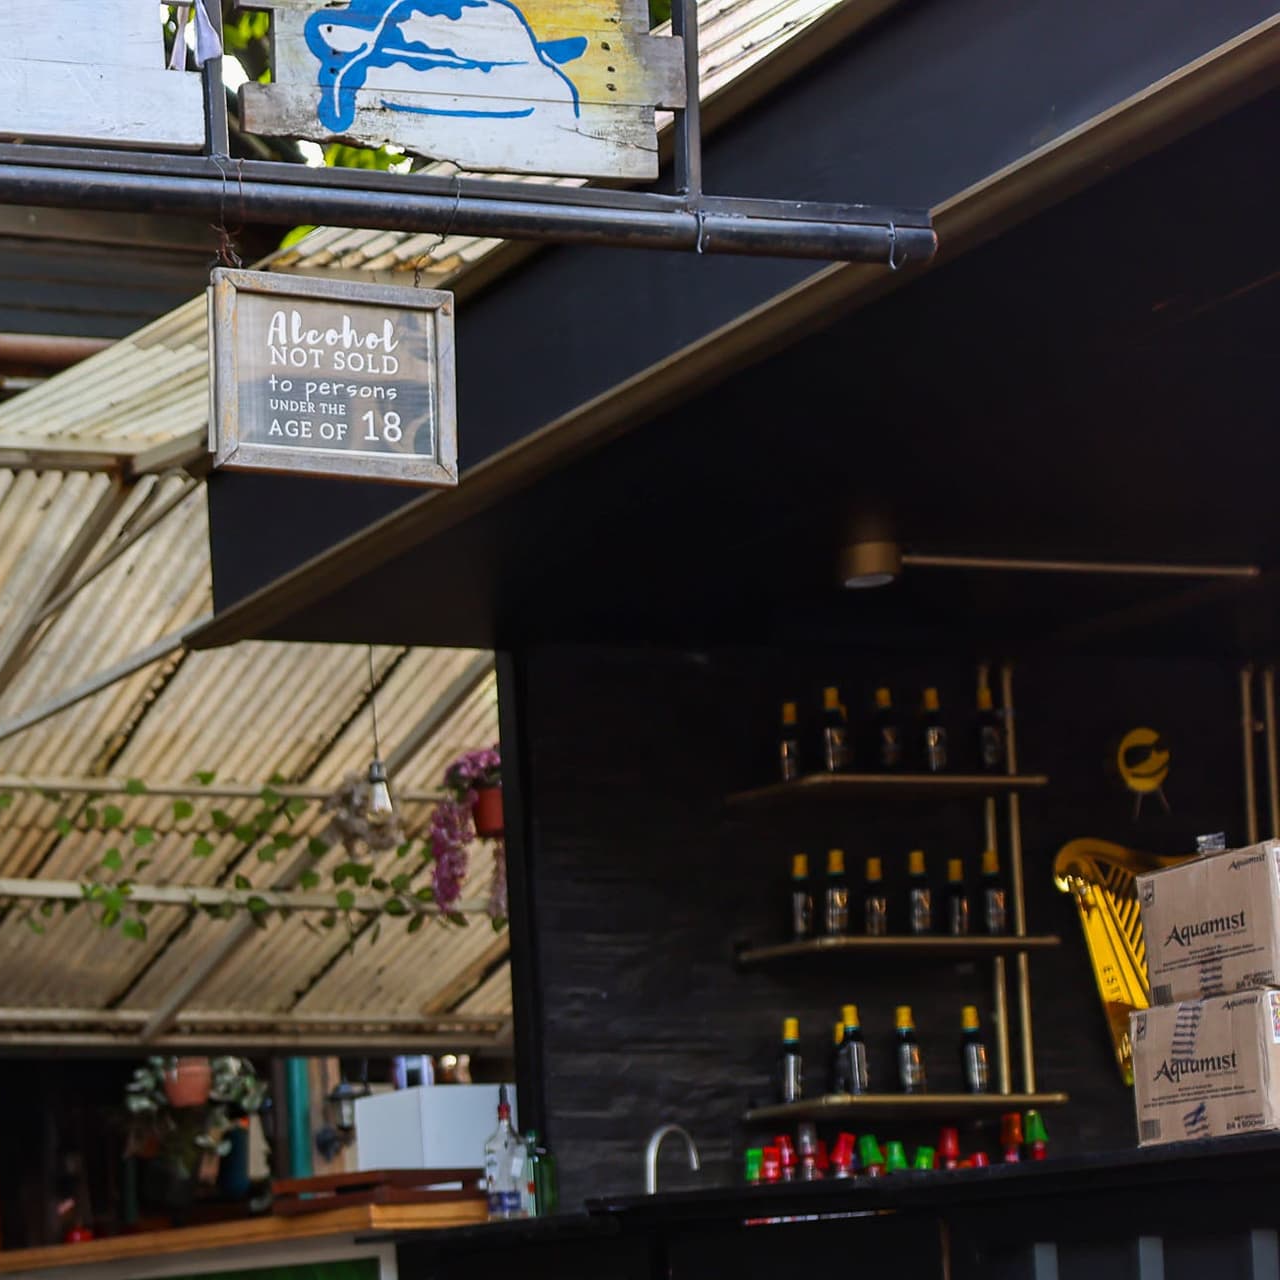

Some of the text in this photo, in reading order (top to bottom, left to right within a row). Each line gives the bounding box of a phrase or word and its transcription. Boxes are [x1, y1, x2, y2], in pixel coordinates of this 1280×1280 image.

[267, 310, 399, 353] Alcohol
[269, 345, 399, 375] NOT SOLD
[269, 374, 398, 402] to persons
[270, 399, 347, 416] UNDER THE
[268, 410, 402, 443] AGE OF 18
[1164, 910, 1246, 947] Aquamist
[1153, 1052, 1237, 1083] Aquamist
